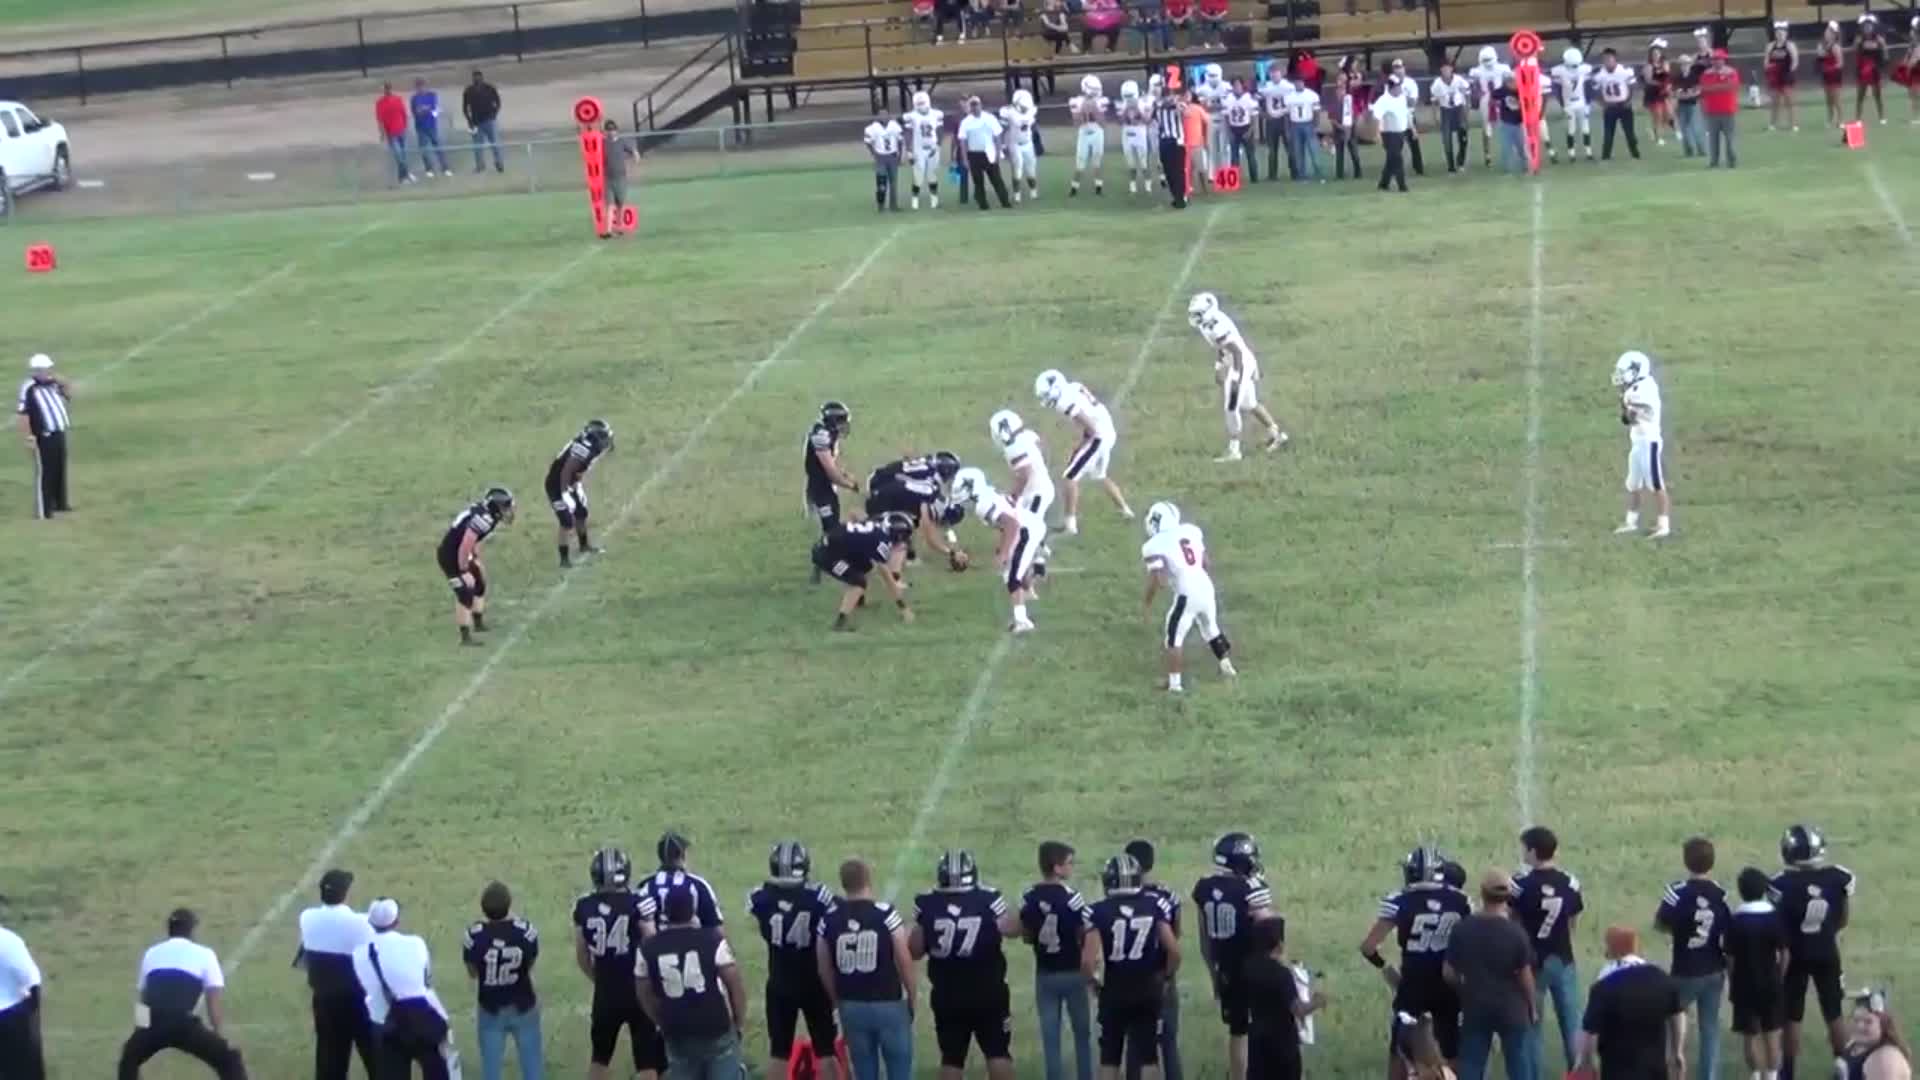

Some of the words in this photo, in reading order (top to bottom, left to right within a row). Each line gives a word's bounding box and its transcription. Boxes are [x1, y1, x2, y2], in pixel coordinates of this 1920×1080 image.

[1216, 171, 1237, 187] 40
[1179, 538, 1196, 566] 6
[586, 914, 630, 957] 34
[769, 911, 811, 949] 14
[930, 916, 982, 959] 37
[1038, 912, 1061, 954] 4
[1108, 915, 1154, 961] 17
[1537, 896, 1563, 939] 7
[1688, 909, 1716, 949] 3
[483, 946, 523, 986] 12
[836, 930, 878, 974] 60
[657, 950, 706, 998] 54
